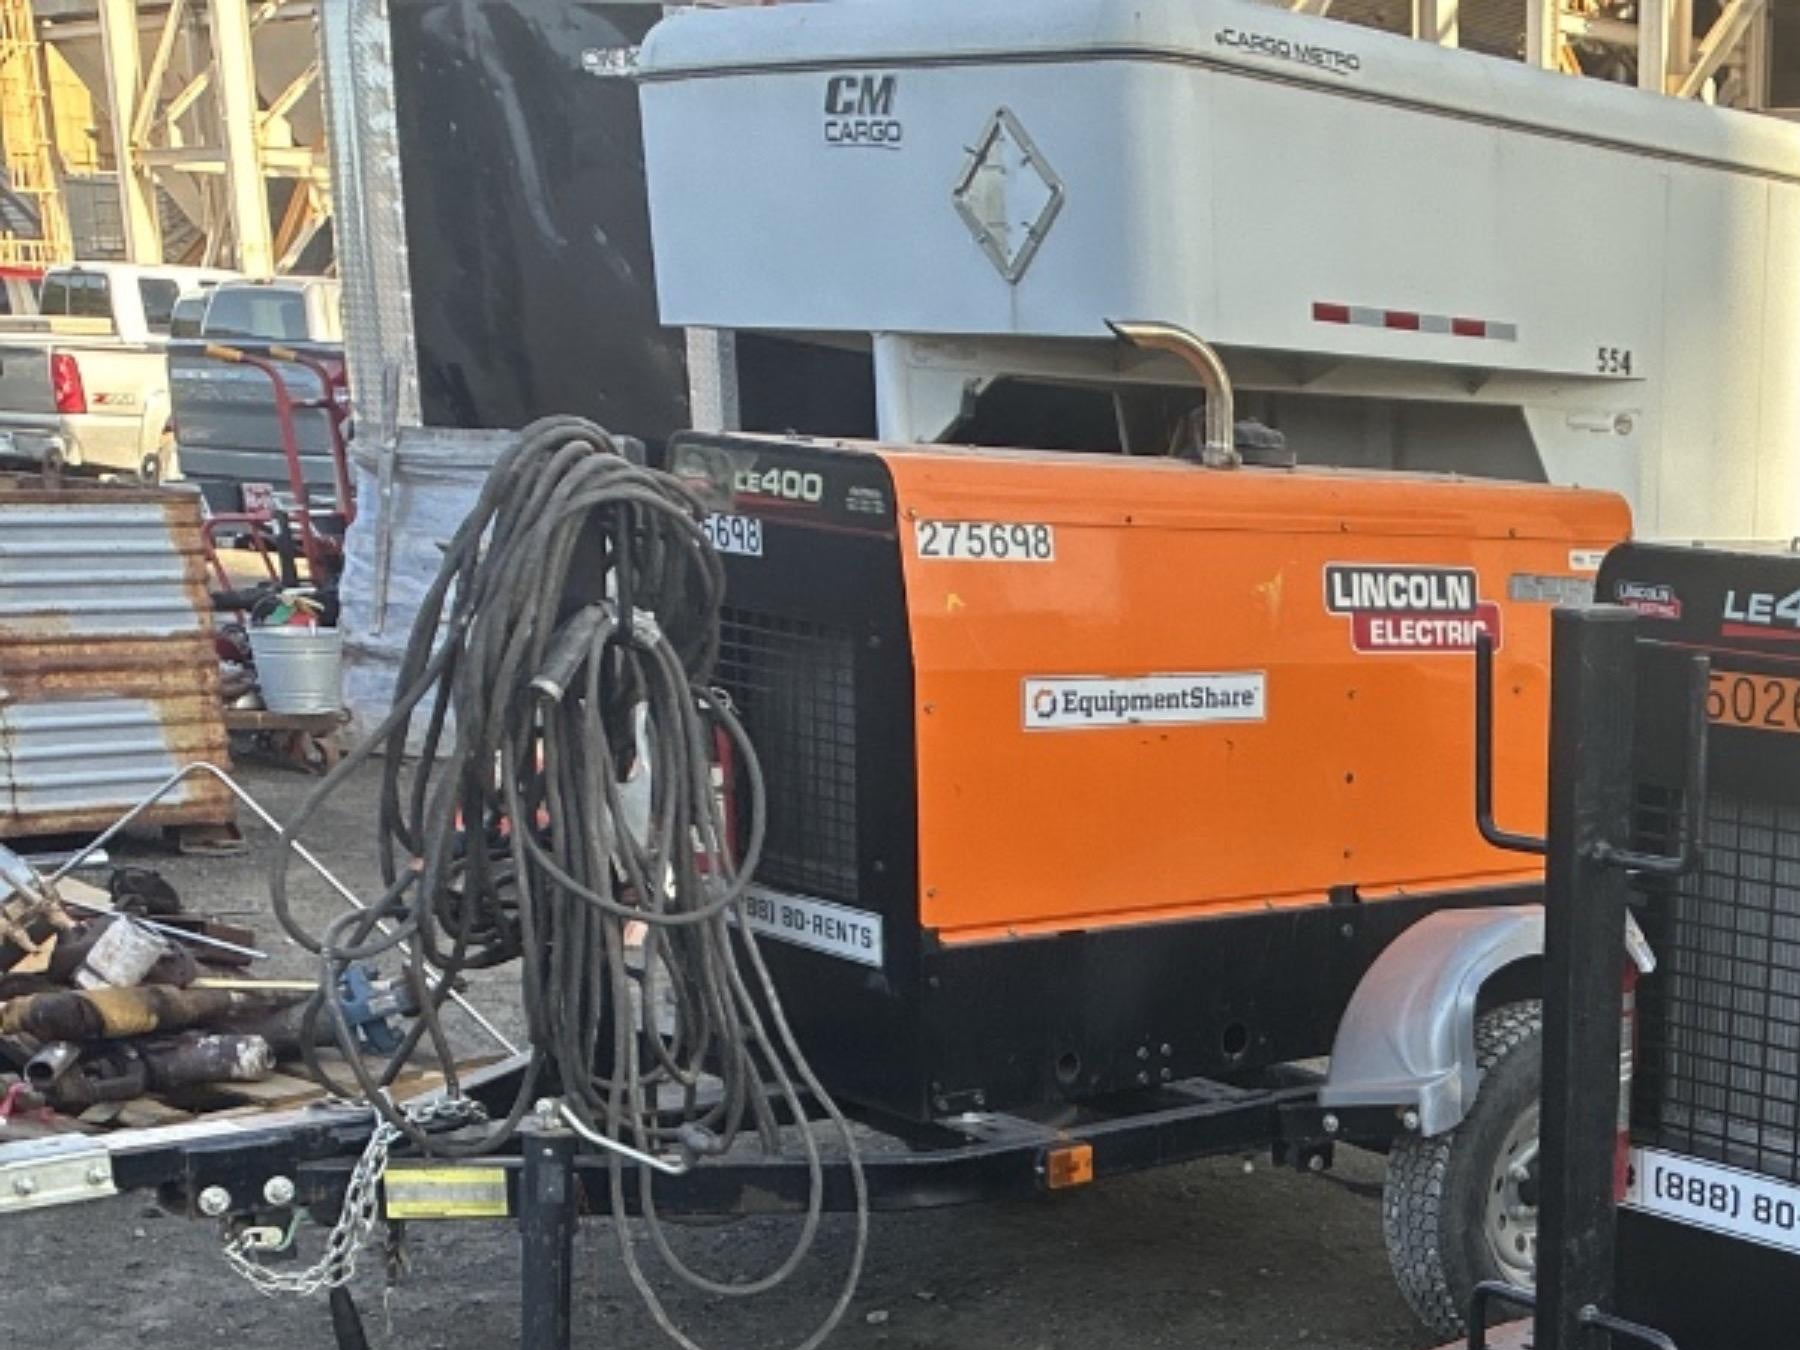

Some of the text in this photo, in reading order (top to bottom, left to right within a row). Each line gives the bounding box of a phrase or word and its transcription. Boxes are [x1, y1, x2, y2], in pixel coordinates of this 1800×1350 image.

[825, 76, 896, 114] CM
[825, 120, 902, 142] CARGO
[1597, 347, 1631, 376] 554
[734, 468, 823, 502] LE400
[702, 513, 761, 552] 5698
[919, 521, 1050, 559] 275698
[1332, 572, 1472, 610] LINCOLN
[1061, 686, 1257, 718] EquipmentShare
[781, 904, 874, 950] 80-RENTS
[1654, 1166, 1741, 1218] (888)
